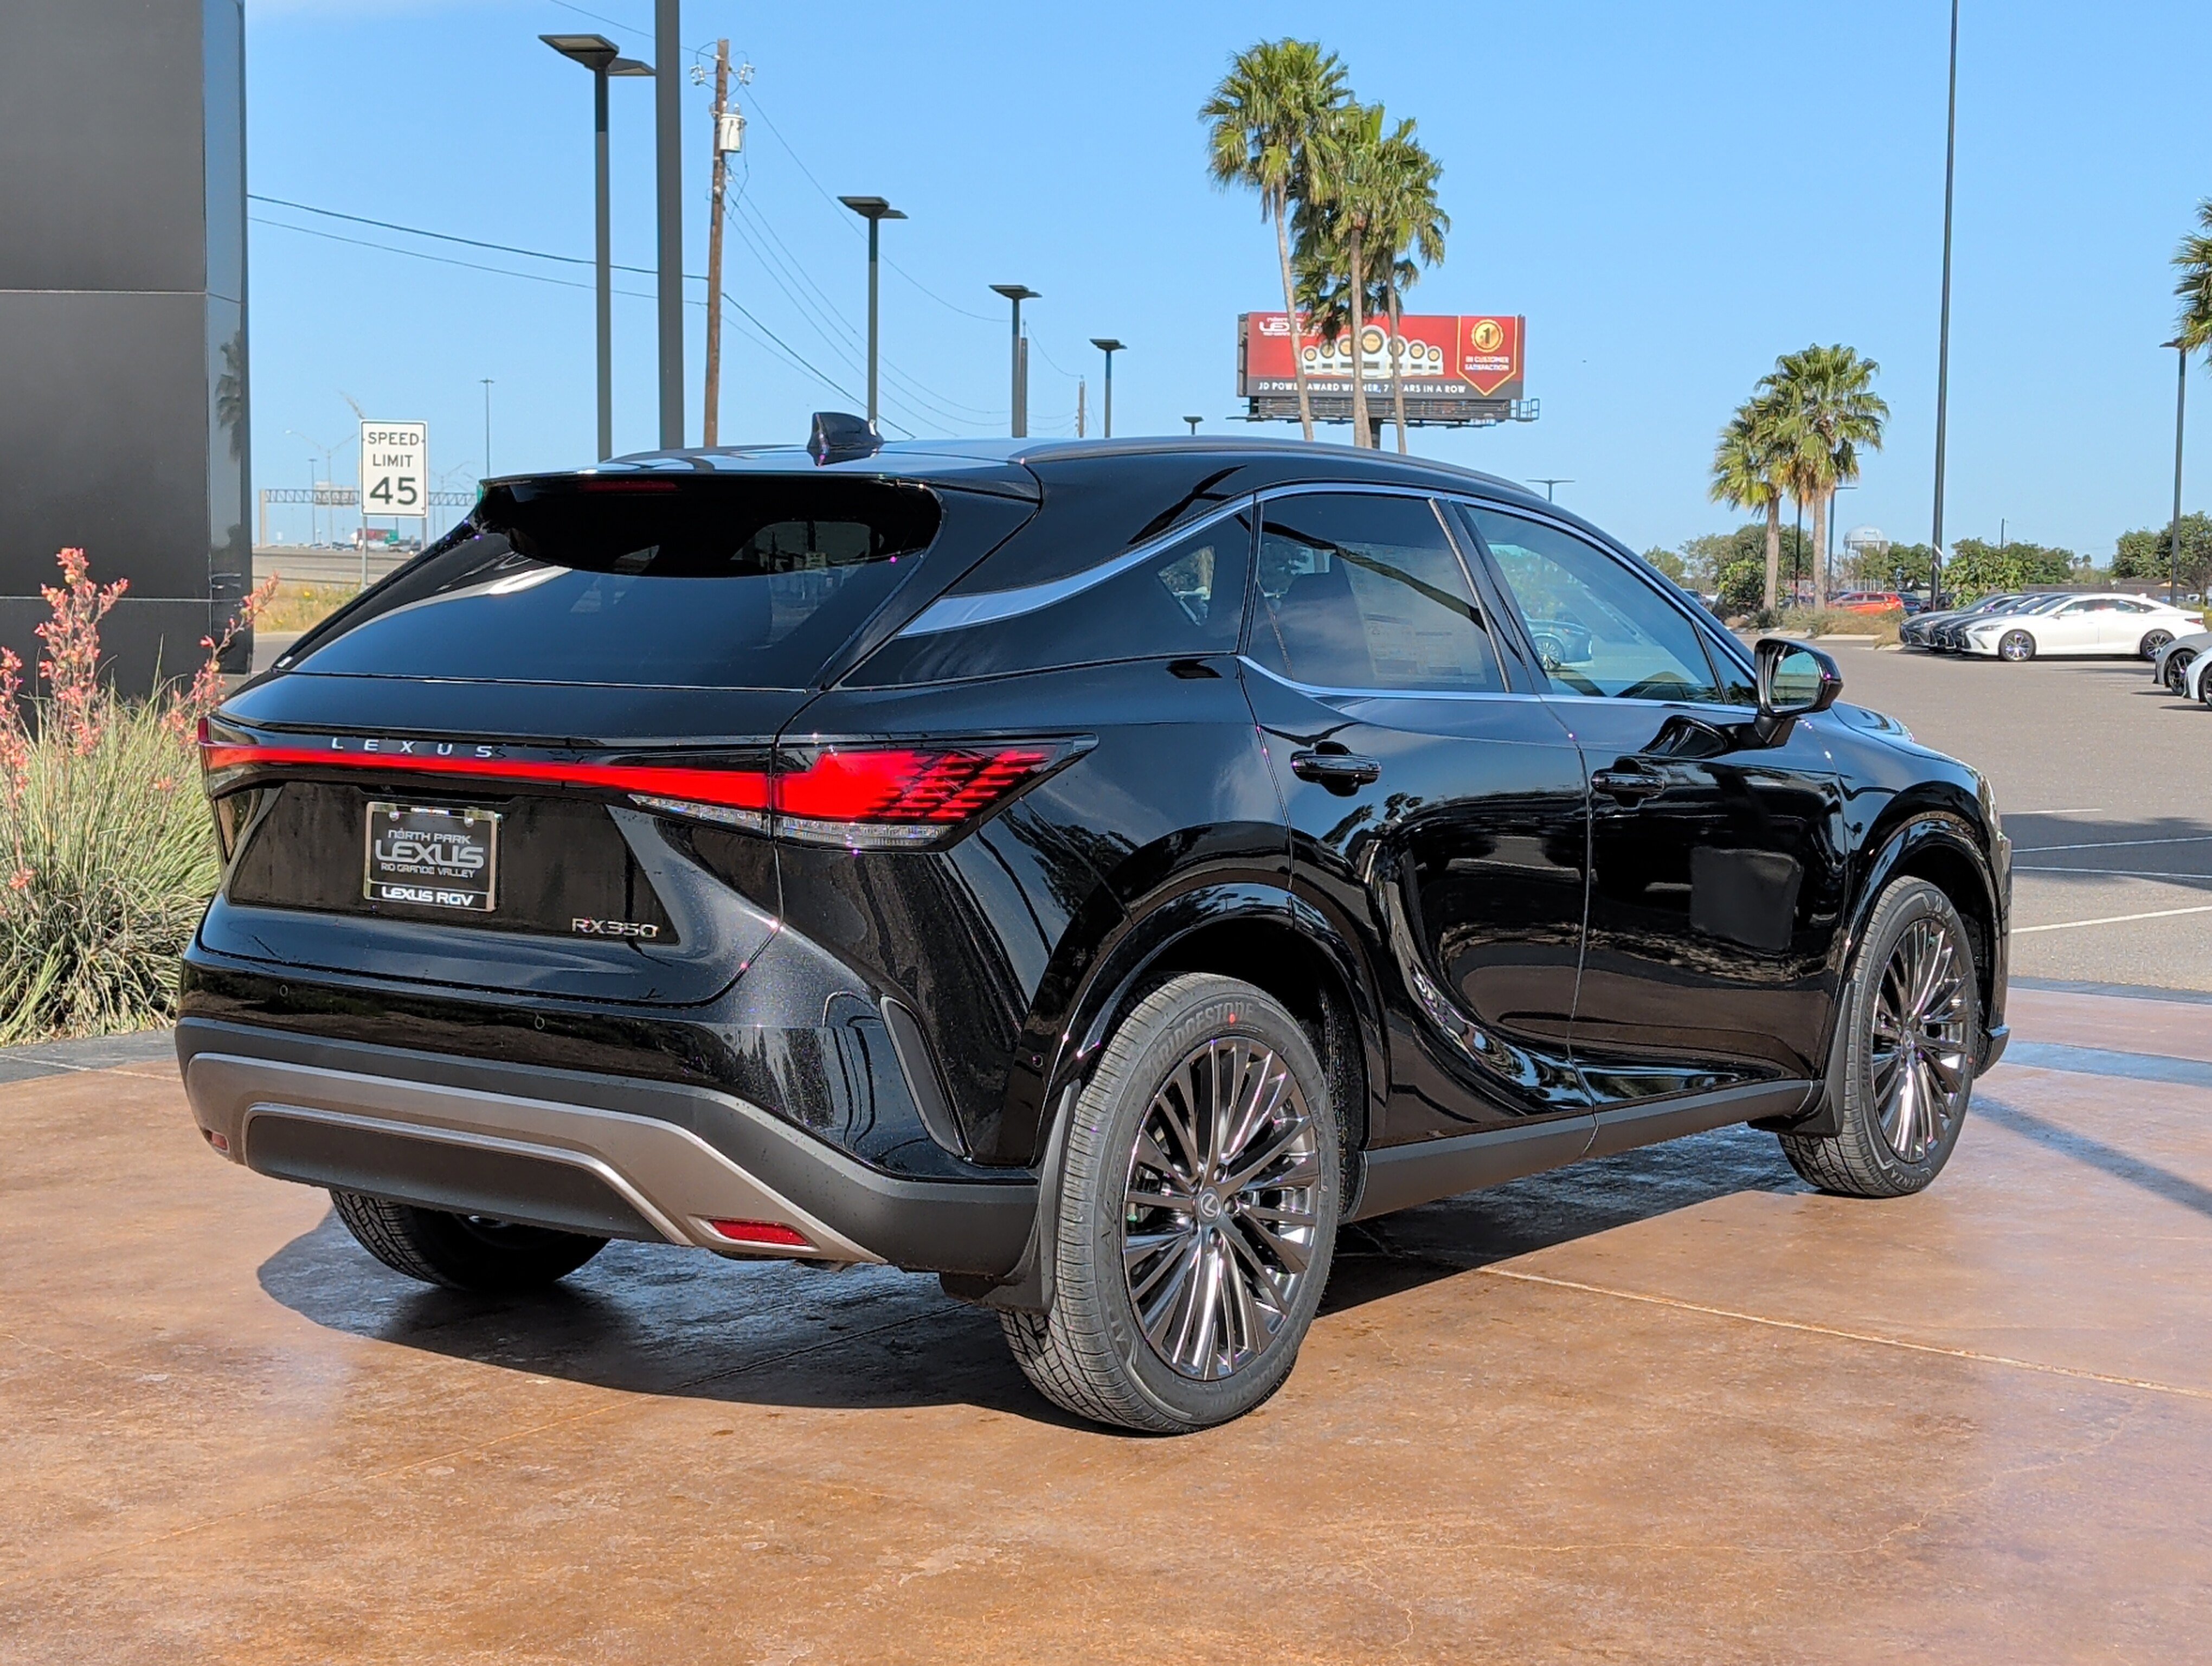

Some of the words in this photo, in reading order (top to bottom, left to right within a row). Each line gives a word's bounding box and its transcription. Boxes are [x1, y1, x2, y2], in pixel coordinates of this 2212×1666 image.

[1258, 382, 1270, 390] JD
[1272, 382, 1300, 391] POWE
[1307, 383, 1340, 392] AWARD
[1342, 383, 1381, 393] WINER,
[1384, 384, 1390, 393] 7
[1391, 384, 1421, 393] ARS
[1423, 385, 1433, 393] IN
[1436, 385, 1442, 393] A
[1445, 385, 1466, 394] ROW
[368, 432, 419, 446] SPEED
[372, 453, 414, 467] LIMIT
[369, 476, 417, 505] 45
[331, 737, 492, 758] LEXUS
[434, 832, 472, 844] PARK
[375, 840, 484, 869] LEXUS
[381, 862, 395, 871] RIO
[397, 864, 435, 875] GRANDE
[437, 867, 476, 878] VALLEY
[381, 886, 433, 902] LEXUS
[436, 892, 474, 906] RGV
[571, 917, 660, 938] RX350
